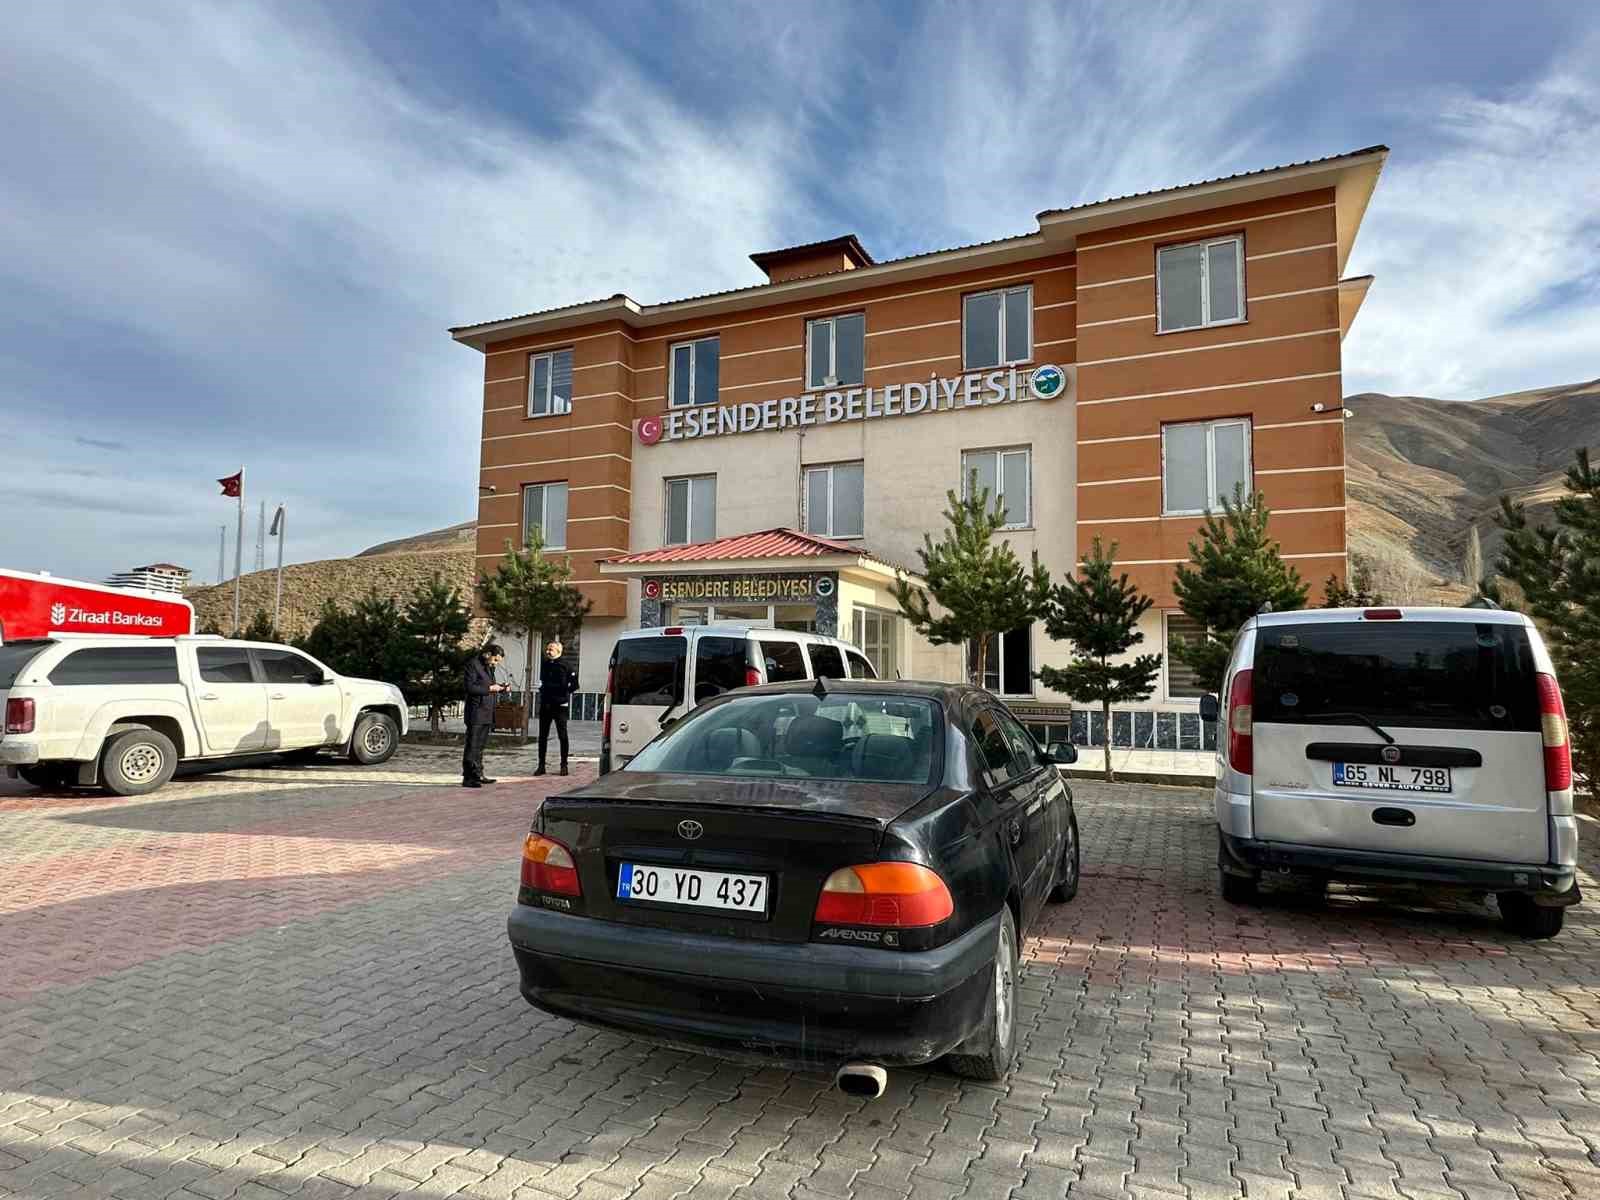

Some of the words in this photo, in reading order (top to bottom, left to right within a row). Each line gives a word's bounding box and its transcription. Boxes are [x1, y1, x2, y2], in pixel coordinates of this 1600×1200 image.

[669, 393, 816, 440] ESENDERE
[824, 362, 1018, 423] BELEDİYESİ
[662, 581, 729, 598] ESENDERE
[733, 575, 812, 598] BELEDİYESİ
[68, 608, 110, 624] Ziraat
[112, 611, 163, 627] Bankası
[1345, 765, 1367, 781] 65
[1378, 766, 1400, 783] NL
[1411, 768, 1446, 786] 798
[632, 869, 658, 897] 30
[675, 873, 702, 901] YD
[717, 877, 762, 907] 437
